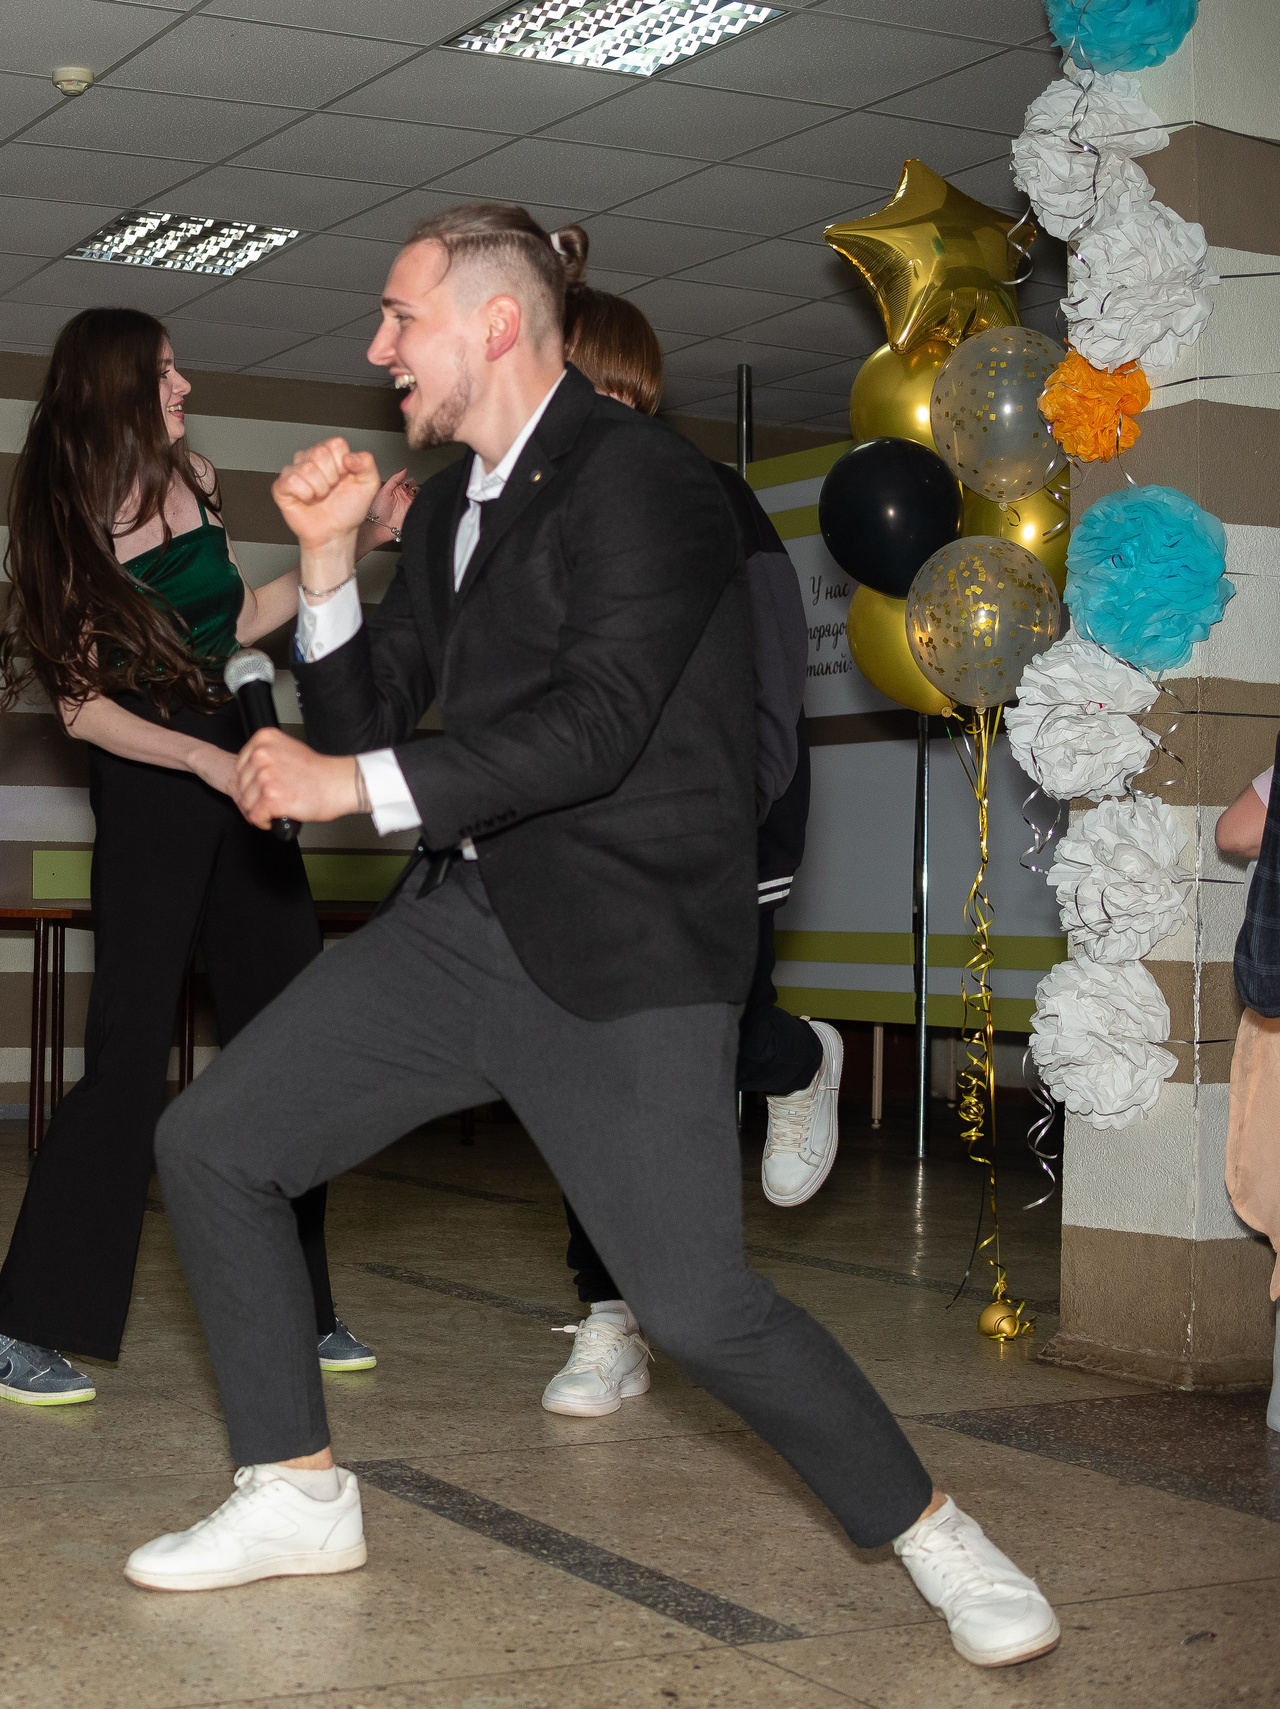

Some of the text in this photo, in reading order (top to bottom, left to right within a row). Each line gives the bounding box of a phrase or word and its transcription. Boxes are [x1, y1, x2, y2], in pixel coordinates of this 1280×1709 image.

[810, 575, 850, 606] У нас
[808, 622, 847, 652] порядо
[806, 654, 852, 678] такой:
